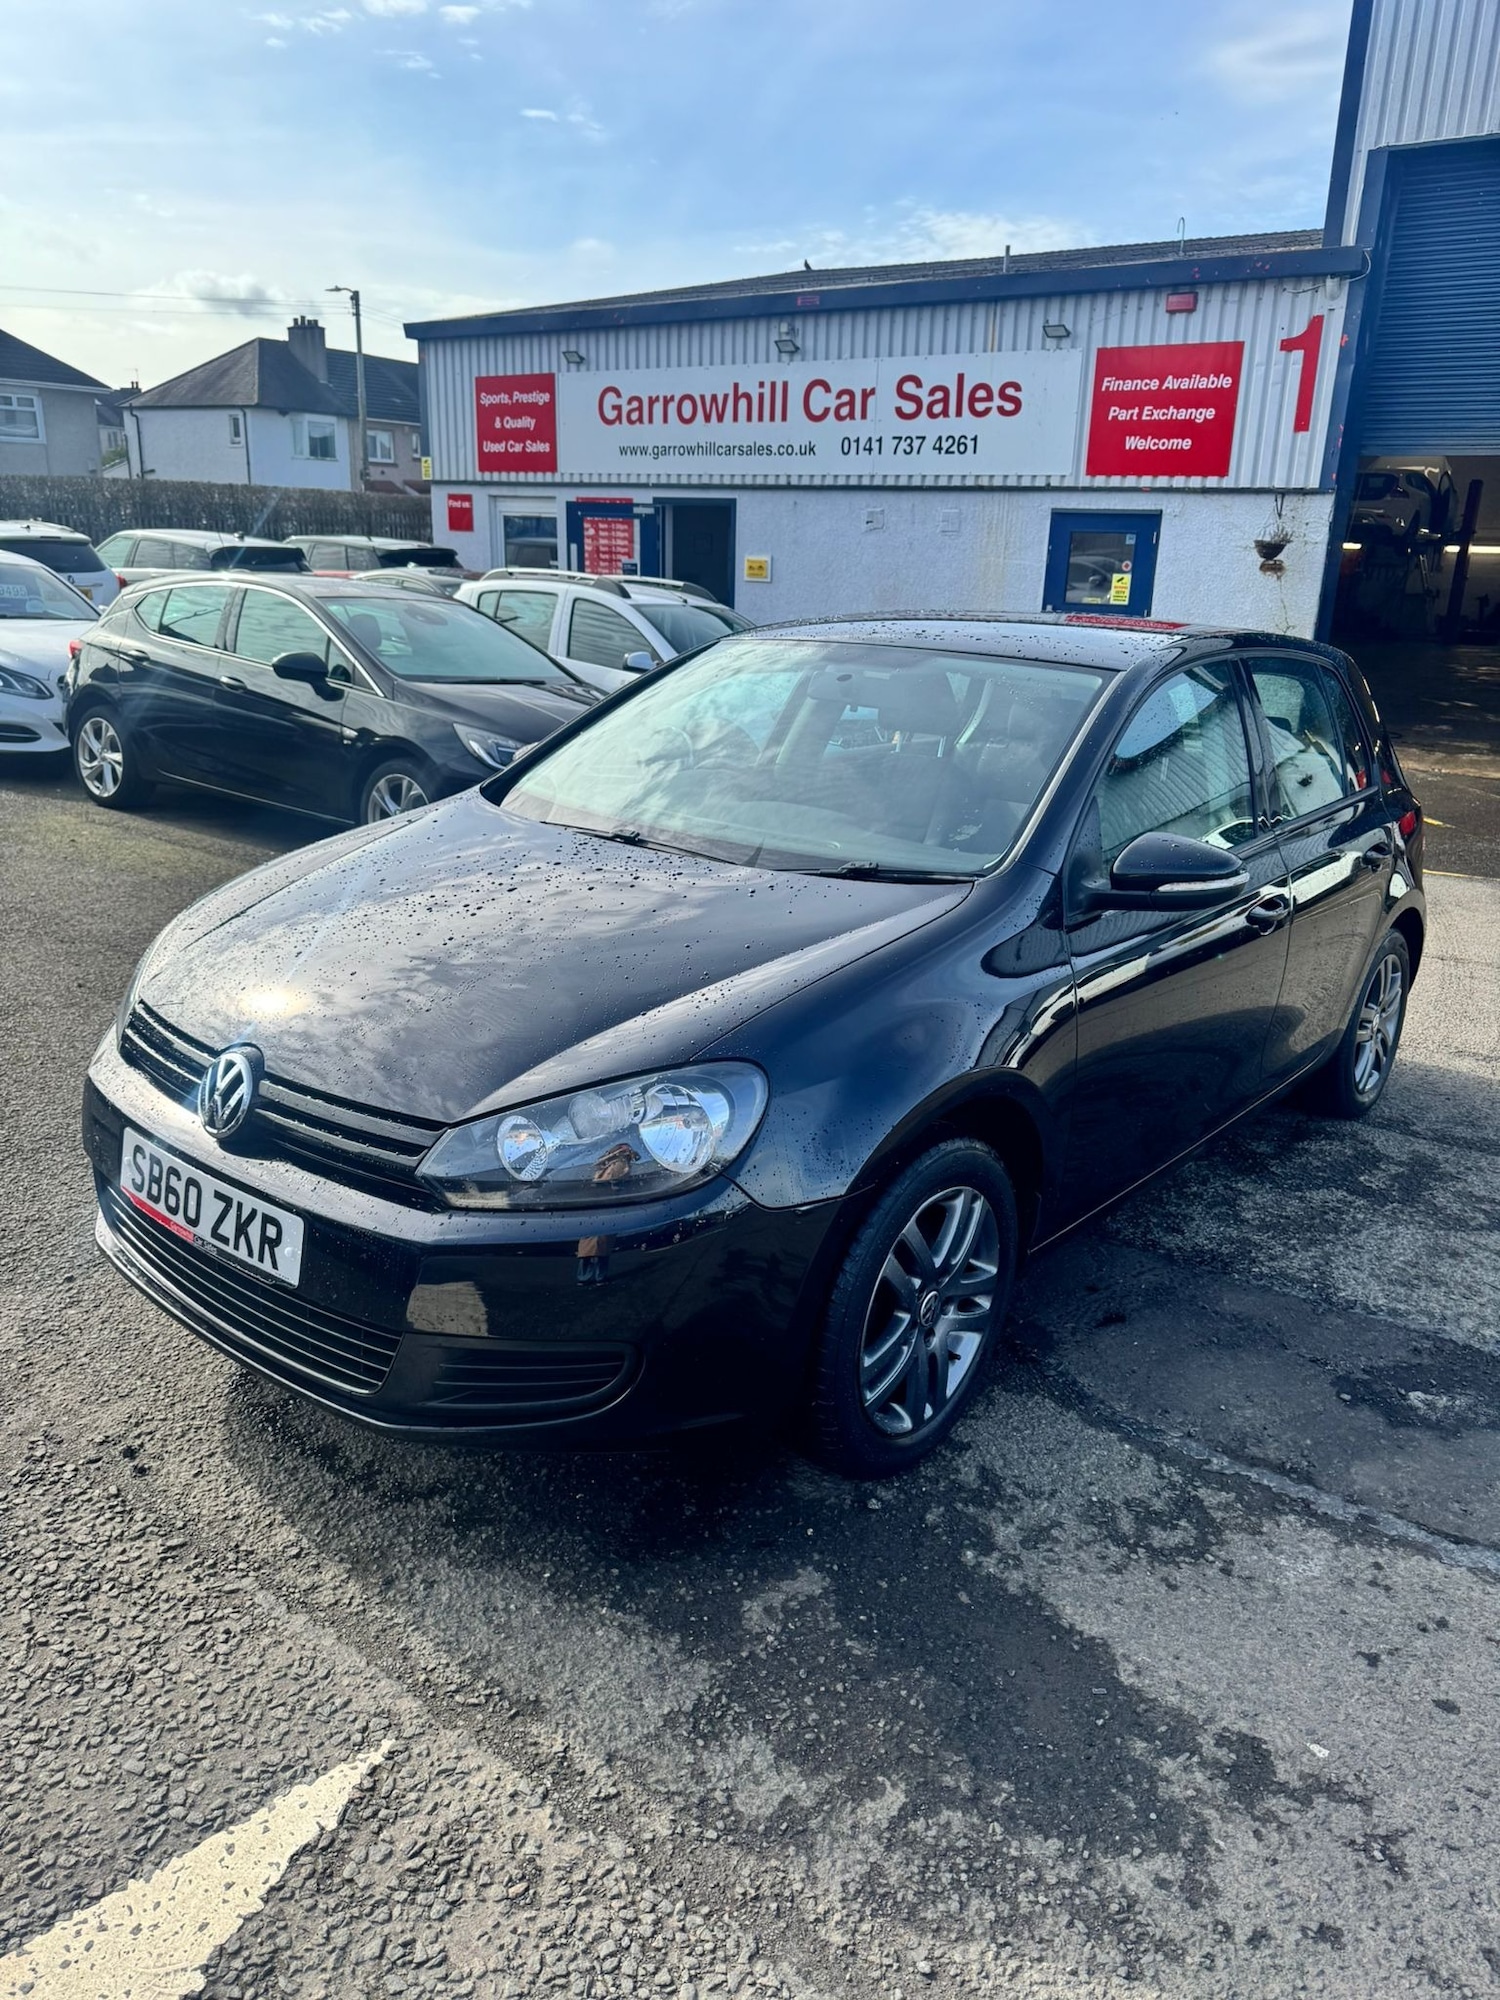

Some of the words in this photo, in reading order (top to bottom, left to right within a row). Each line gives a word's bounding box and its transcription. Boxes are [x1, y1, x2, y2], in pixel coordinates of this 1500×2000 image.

[1101, 376, 1160, 391] Finance
[1161, 374, 1233, 390] Available
[1279, 315, 1324, 433] 1
[480, 392, 512, 407] Sports,
[512, 390, 551, 406] Prestige
[597, 380, 789, 427] Garrowhill
[802, 378, 876, 423] Car
[894, 372, 1023, 421] Sales
[1108, 406, 1139, 421] Part
[1141, 405, 1216, 423] Exchange
[494, 416, 502, 429] &
[503, 416, 536, 431] Quality
[483, 440, 506, 453] Used
[507, 440, 524, 453] Car
[525, 440, 551, 453] Sales
[618, 440, 817, 460] www.garrowhillcarsales.co.uk
[840, 436, 884, 456] 0141
[891, 435, 927, 456] 737
[932, 434, 979, 455] 4261
[1125, 436, 1192, 451] Welcome
[131, 1144, 203, 1228] SB60
[210, 1189, 283, 1271] ZKR
